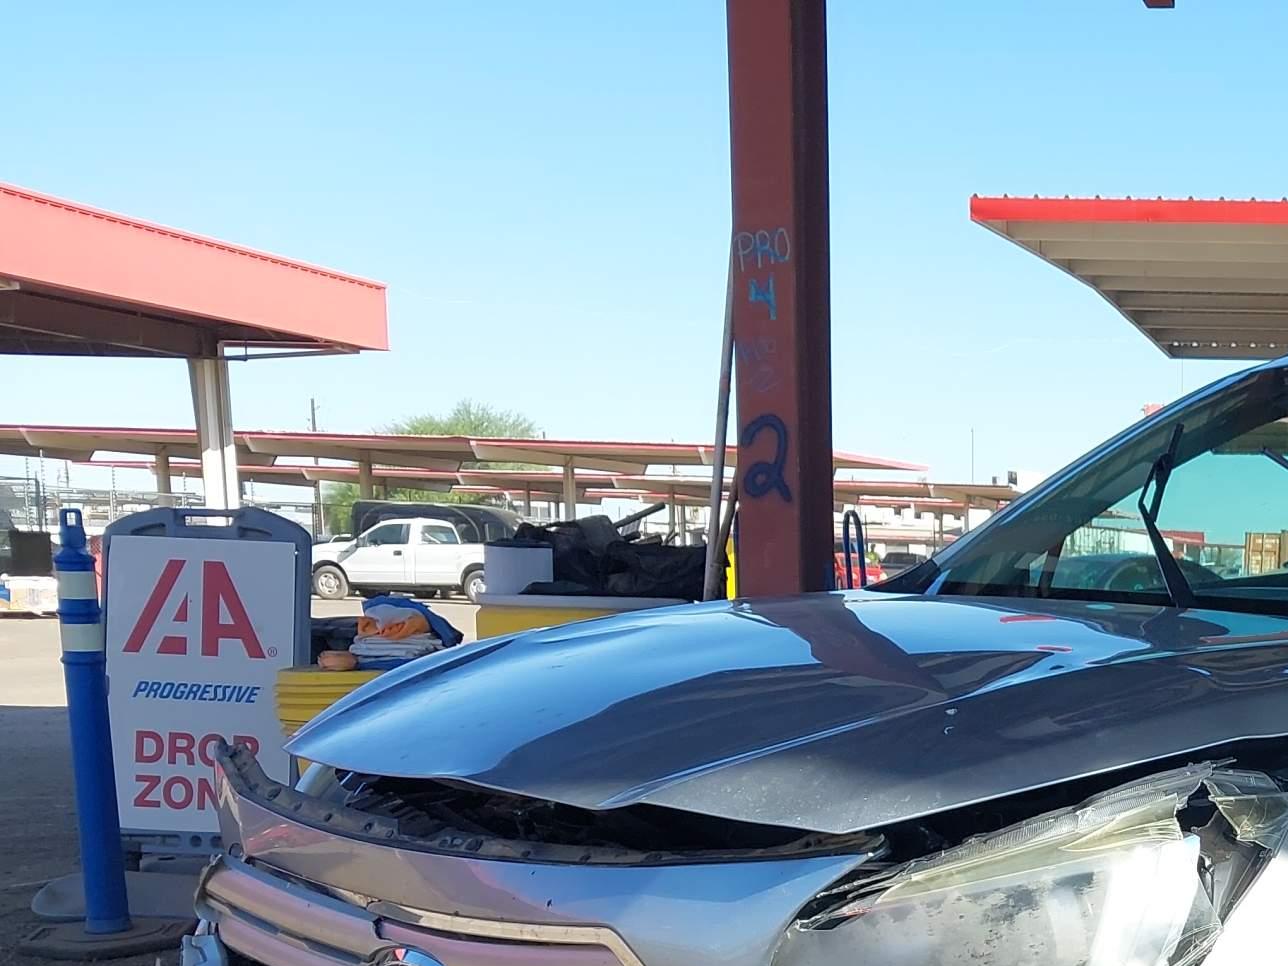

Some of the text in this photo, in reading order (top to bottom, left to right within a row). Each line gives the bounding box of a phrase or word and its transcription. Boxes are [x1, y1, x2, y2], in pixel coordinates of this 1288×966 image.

[749, 275, 776, 320] 4
[741, 413, 793, 502] 2
[132, 680, 261, 704] PROGRESSIVE
[133, 774, 218, 811] ZON
